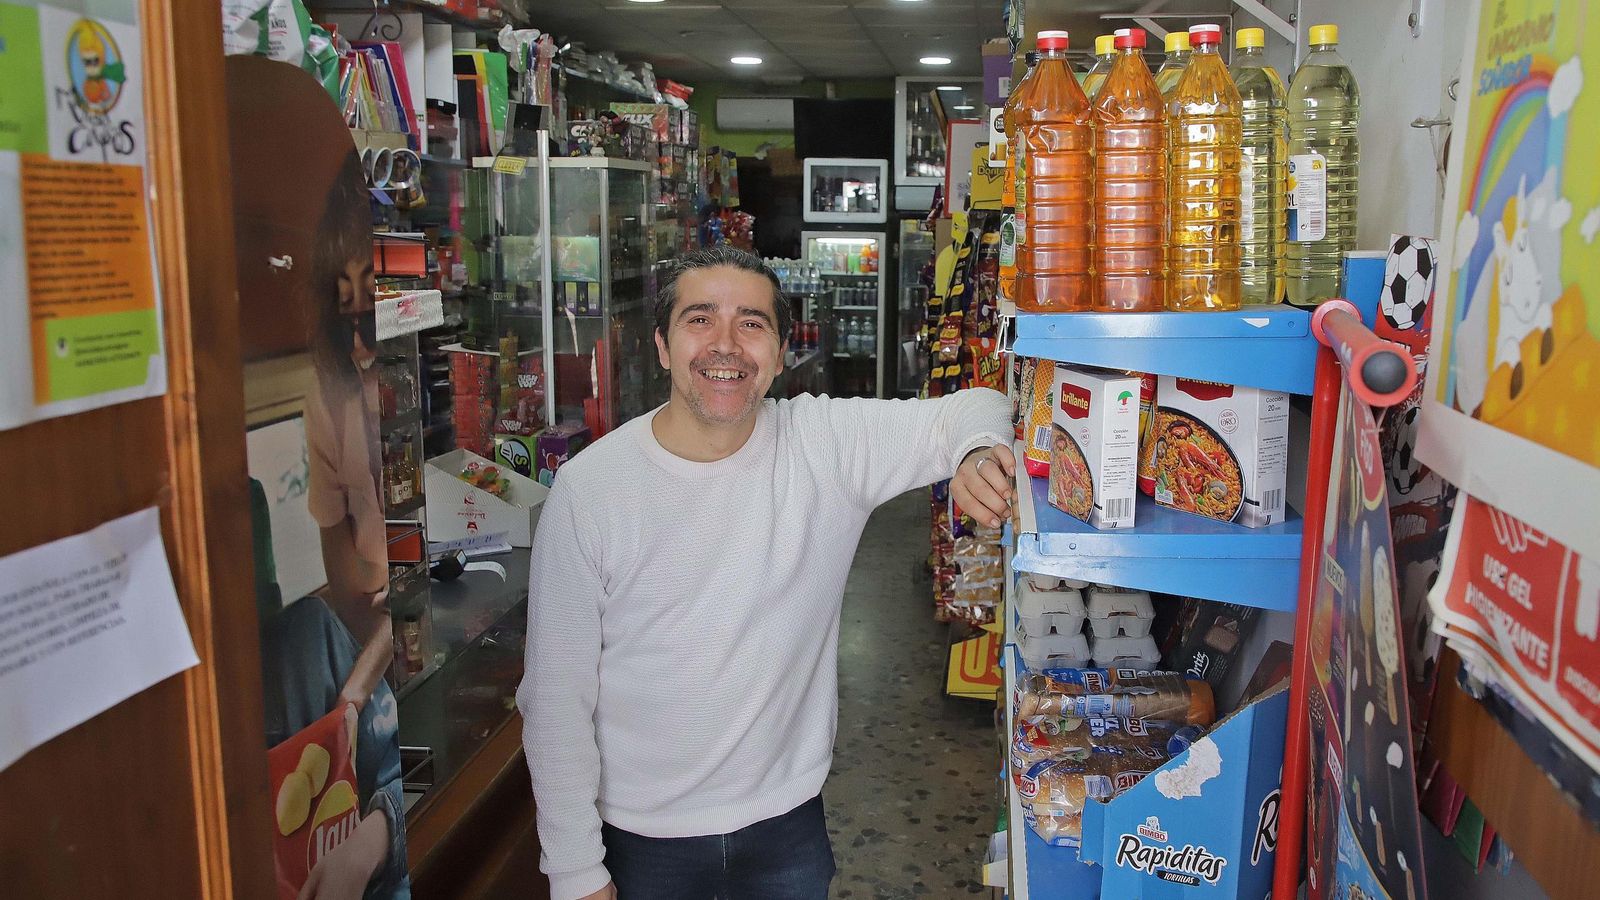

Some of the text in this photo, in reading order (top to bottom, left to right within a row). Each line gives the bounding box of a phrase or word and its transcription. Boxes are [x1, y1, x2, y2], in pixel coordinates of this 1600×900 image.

[1062, 390, 1089, 410] brillante
[1483, 553, 1533, 611] USE GEL
[1464, 581, 1550, 669] HIGIENIZANTE
[1138, 826, 1167, 842] BIMBO
[1117, 834, 1227, 881] Rapiditas
[1163, 872, 1195, 885] TORTILLAS
